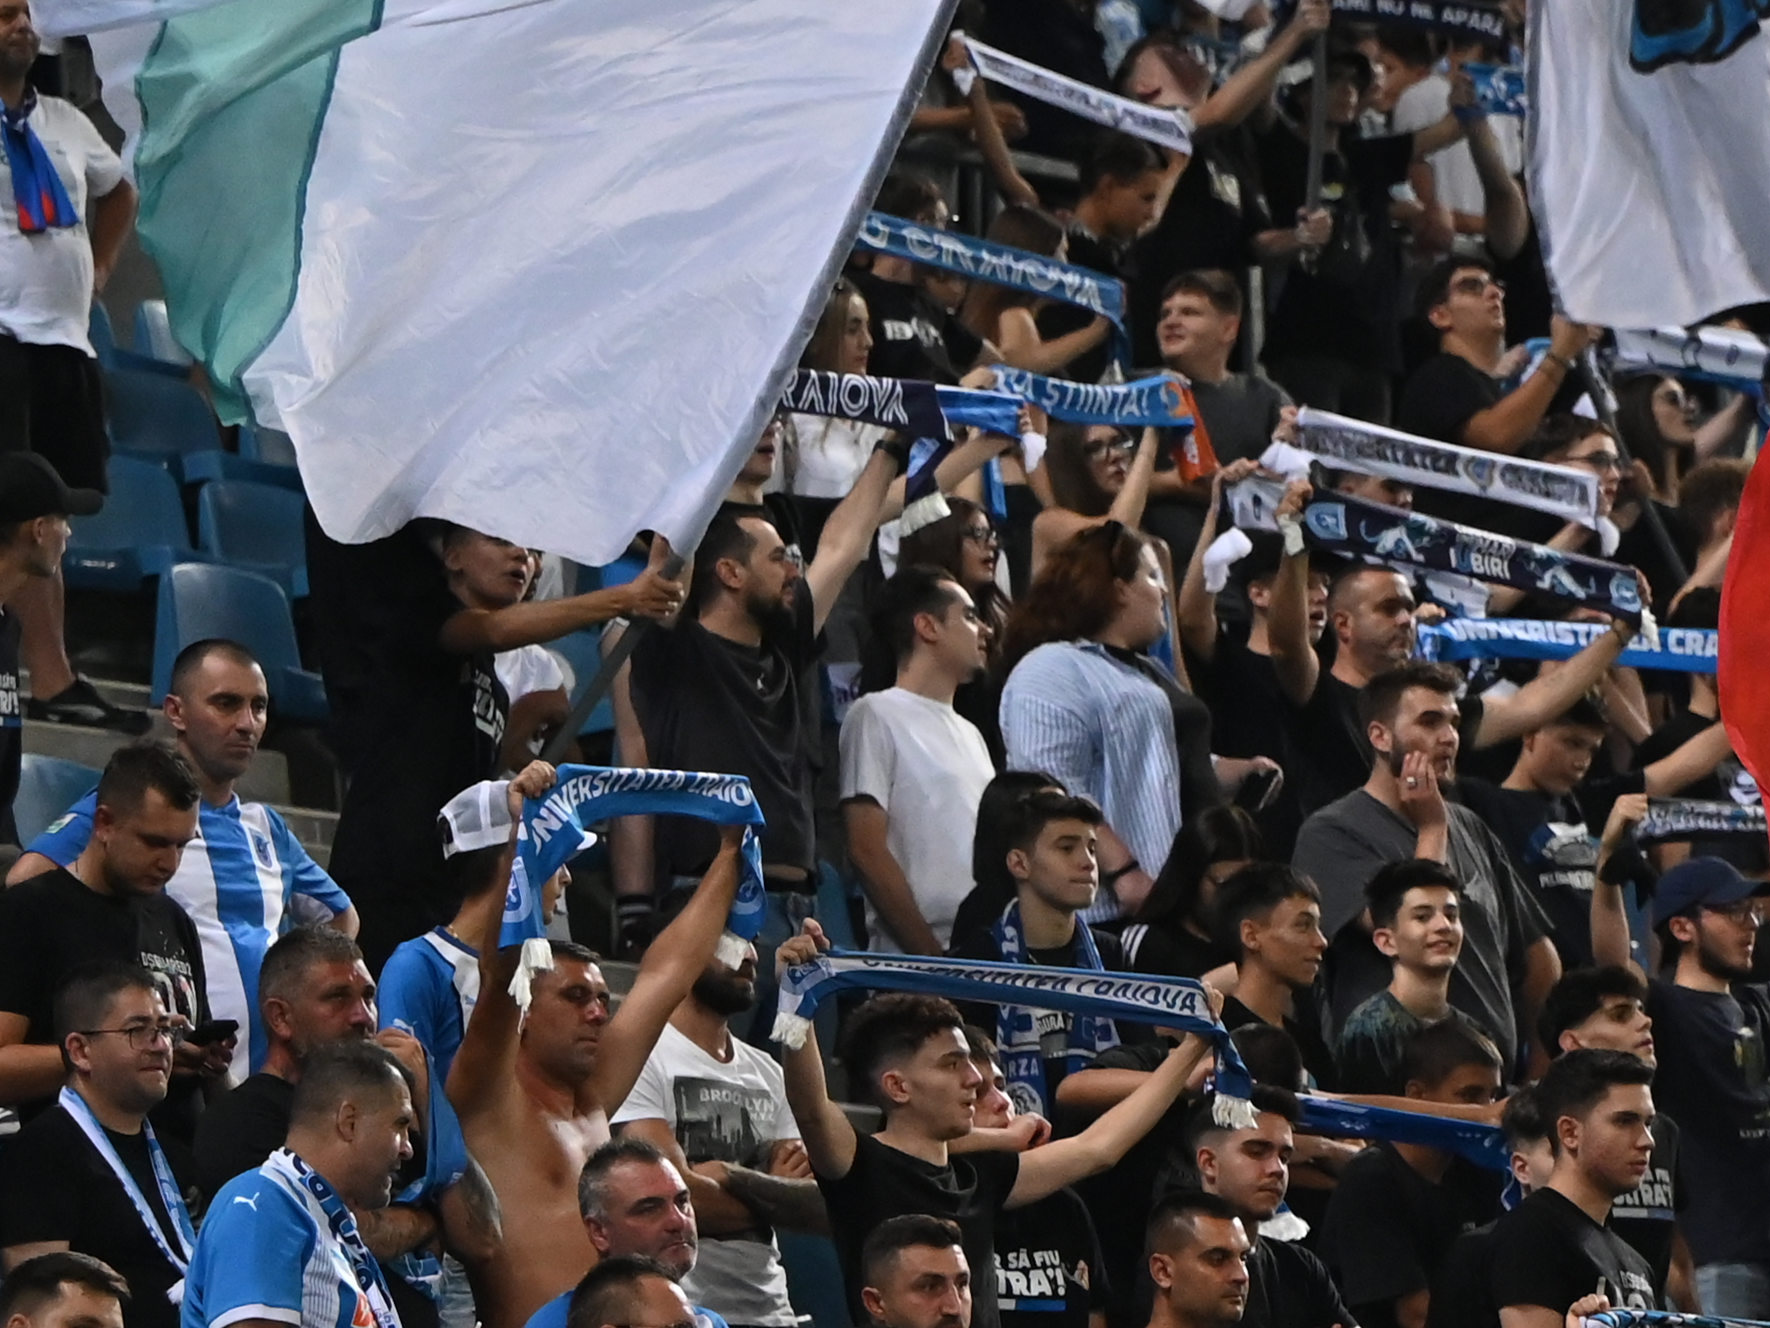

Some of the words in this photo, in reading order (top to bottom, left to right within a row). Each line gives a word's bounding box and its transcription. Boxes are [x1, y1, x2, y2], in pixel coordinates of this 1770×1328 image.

[699, 1086, 776, 1113] BROOLYN
[1008, 1248, 1031, 1269] SĂ
[1034, 1248, 1060, 1267] FIU
